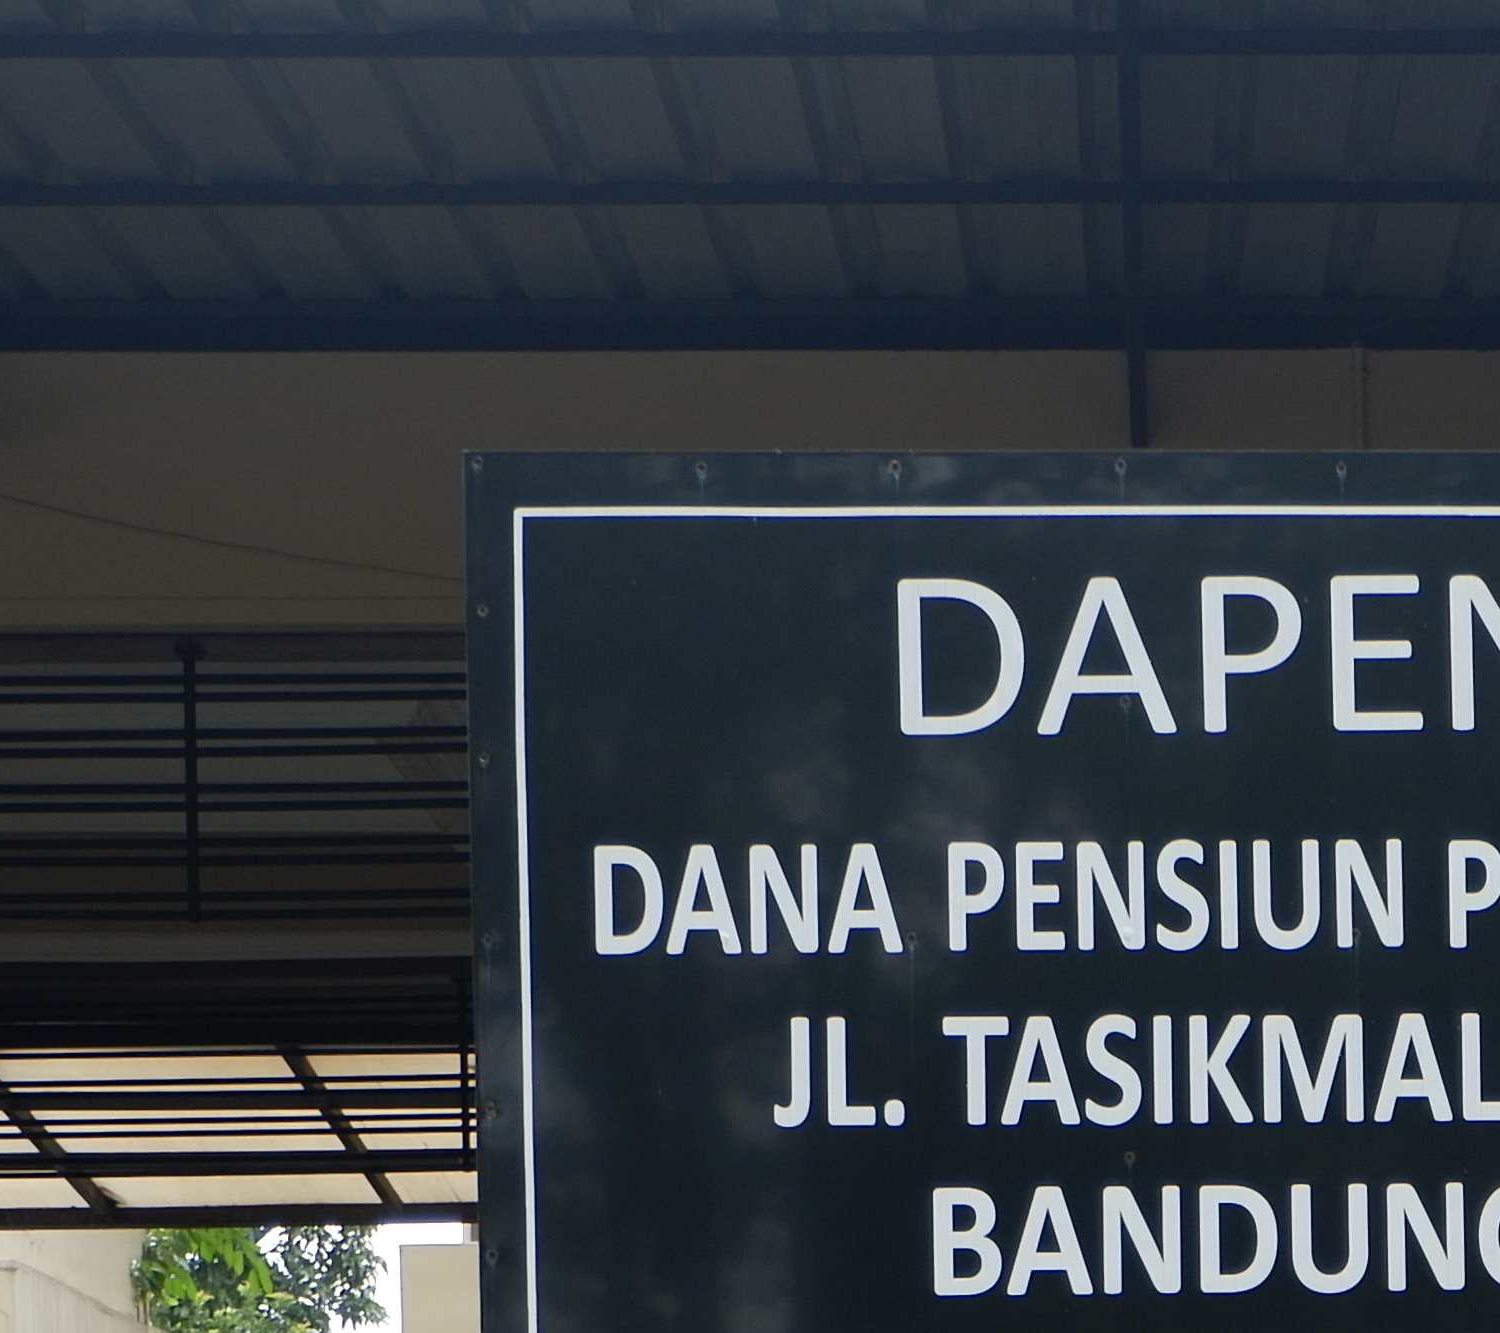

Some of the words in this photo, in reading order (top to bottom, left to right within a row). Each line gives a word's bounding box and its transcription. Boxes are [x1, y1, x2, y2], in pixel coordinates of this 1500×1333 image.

[592, 843, 905, 956] DANA
[946, 838, 1405, 952] PENSIUN
[773, 1016, 906, 1128] JL.
